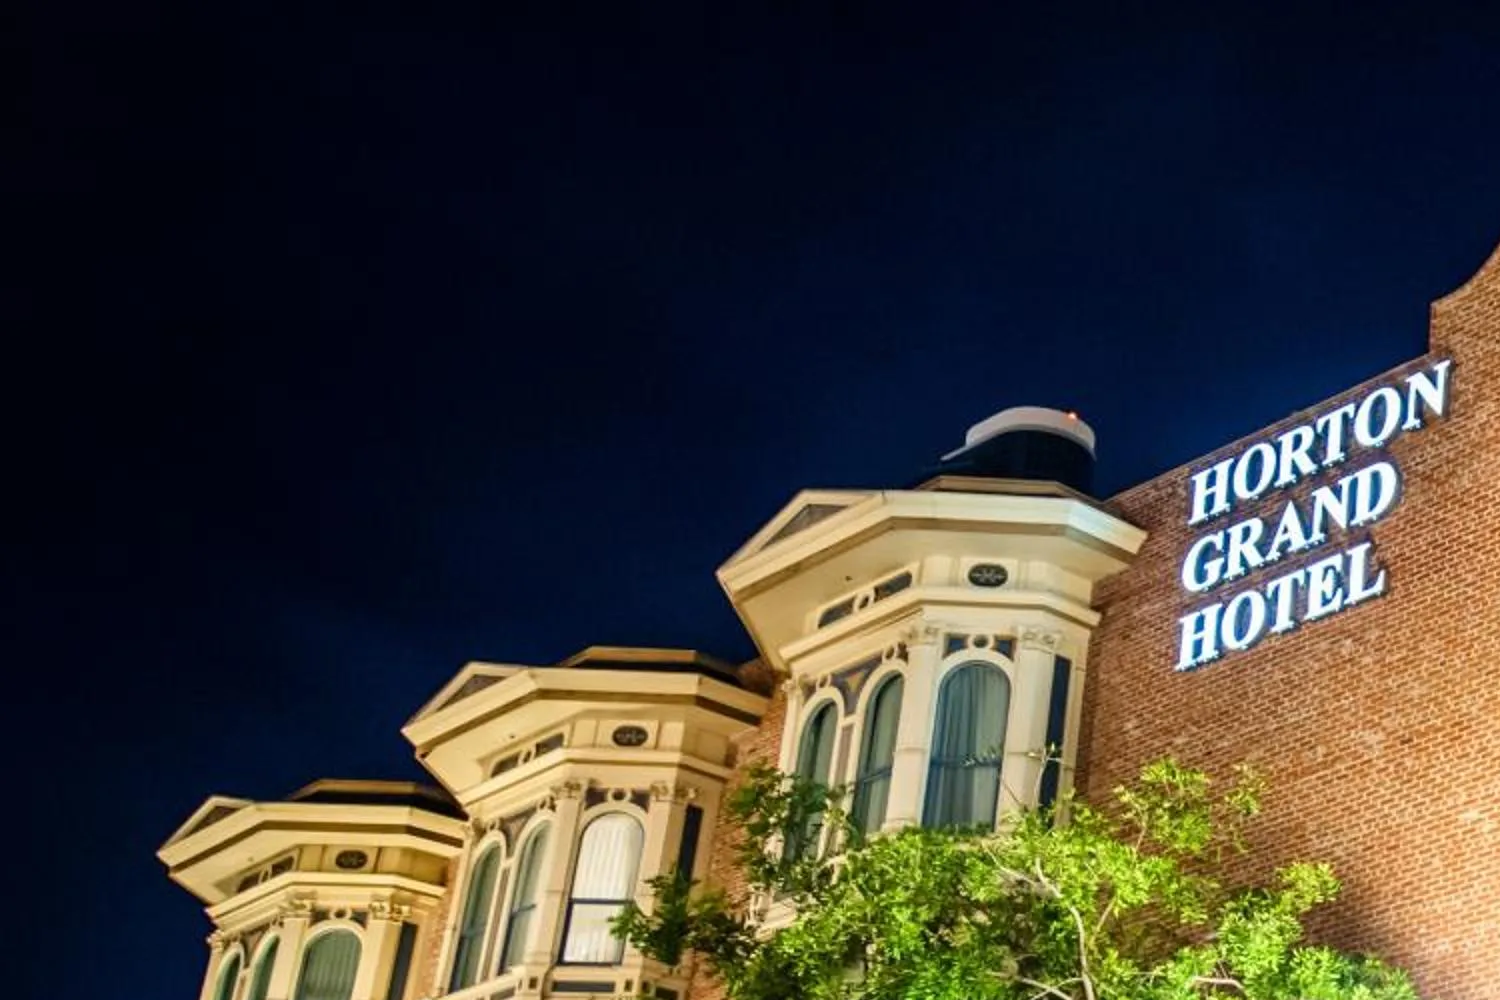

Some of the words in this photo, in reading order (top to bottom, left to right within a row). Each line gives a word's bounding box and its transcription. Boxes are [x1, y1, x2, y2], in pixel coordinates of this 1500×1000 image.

[1188, 360, 1451, 525] HORTON
[1181, 461, 1397, 593] GRAND
[1175, 542, 1386, 672] HOTEL
